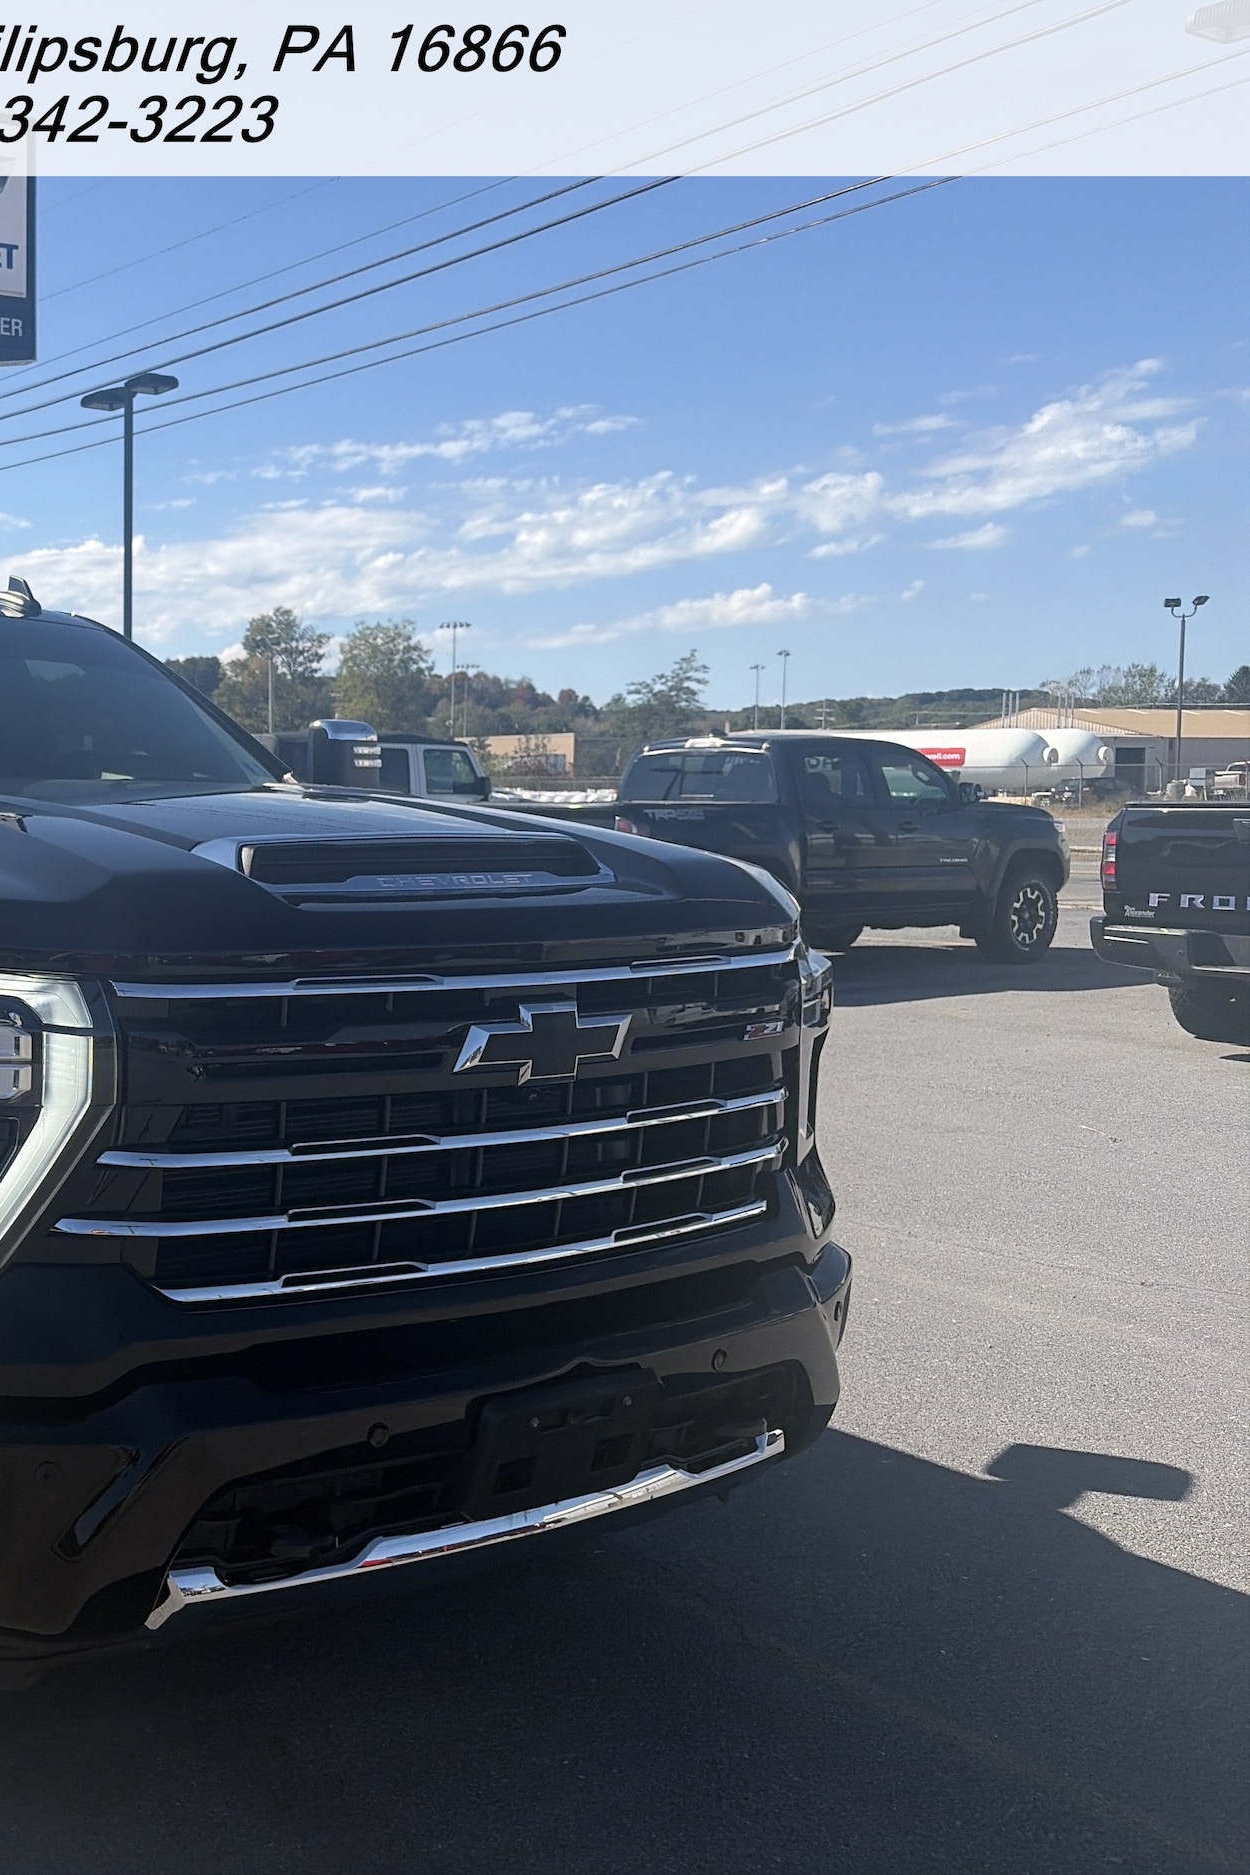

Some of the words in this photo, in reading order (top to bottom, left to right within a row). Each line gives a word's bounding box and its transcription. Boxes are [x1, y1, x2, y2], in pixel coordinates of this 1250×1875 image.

[926, 752, 961, 760] well.com
[376, 874, 532, 887] CHEVROLET
[743, 1021, 784, 1040] Z71
